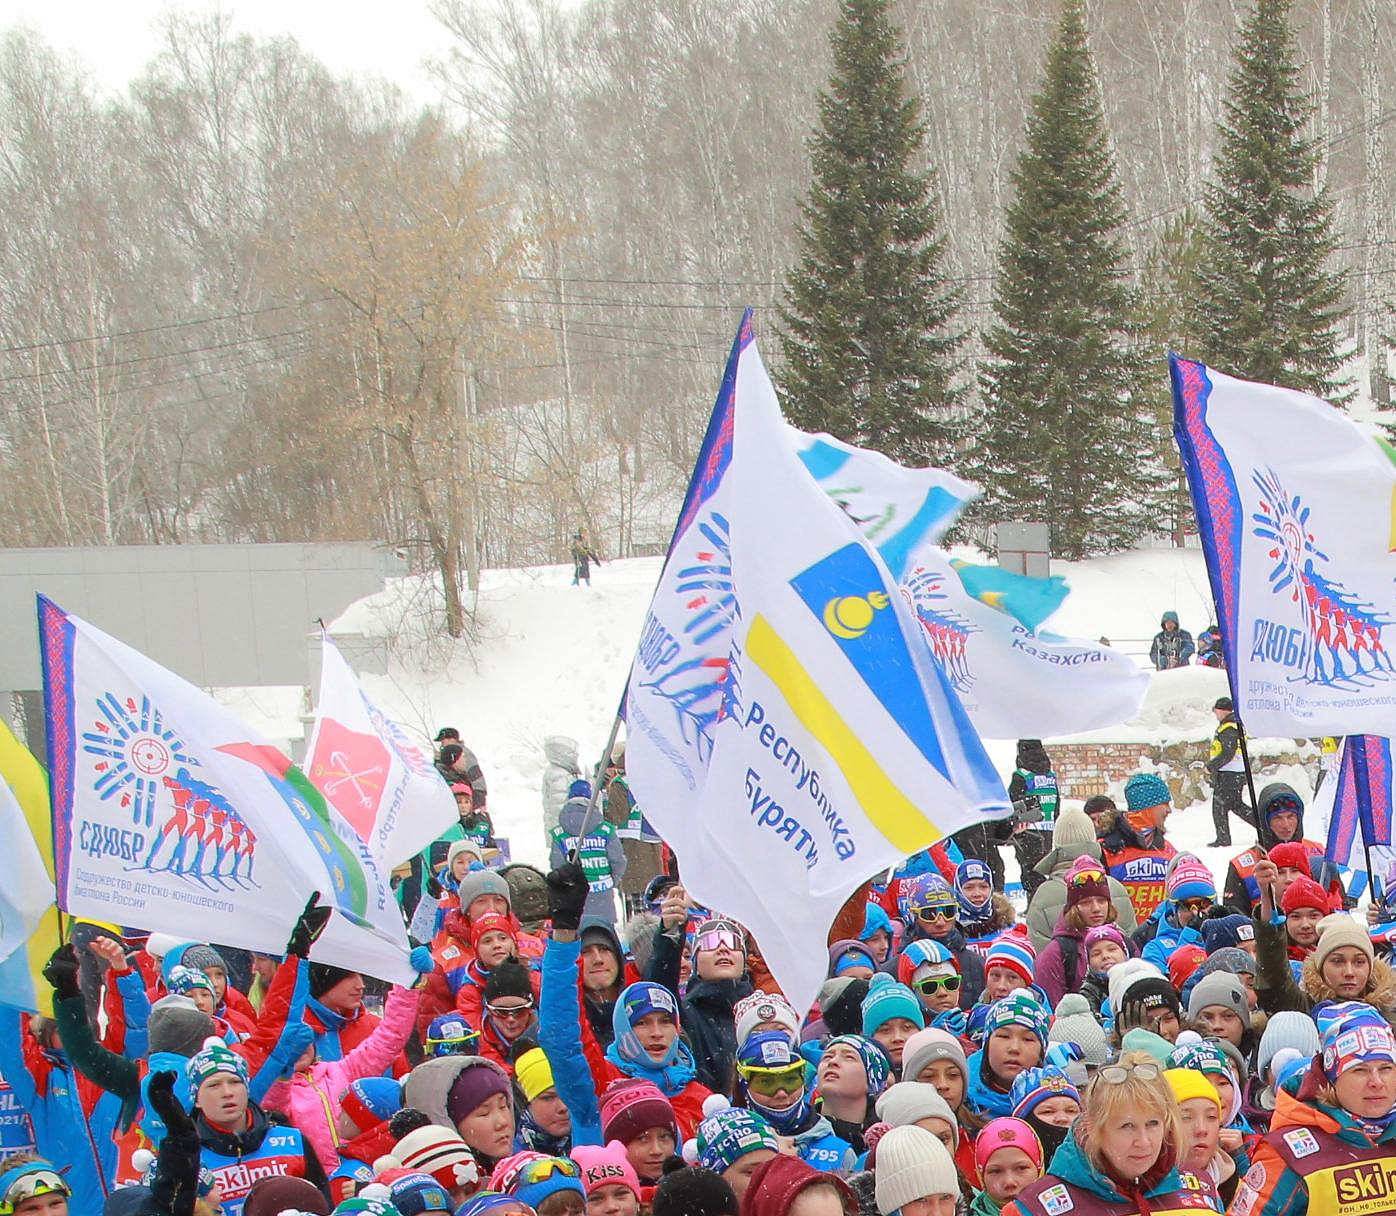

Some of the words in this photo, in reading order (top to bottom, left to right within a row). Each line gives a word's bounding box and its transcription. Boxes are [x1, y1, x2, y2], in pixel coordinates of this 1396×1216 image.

[744, 700, 856, 862] Республика
[80, 819, 145, 864] СДЮБР
[1126, 858, 1168, 877] skimi
[268, 1136, 296, 1147] 971
[717, 1127, 752, 1153] ЕСТНО
[809, 1148, 839, 1162] 795
[214, 1159, 288, 1191] skimir
[586, 1165, 625, 1184] Kiss
